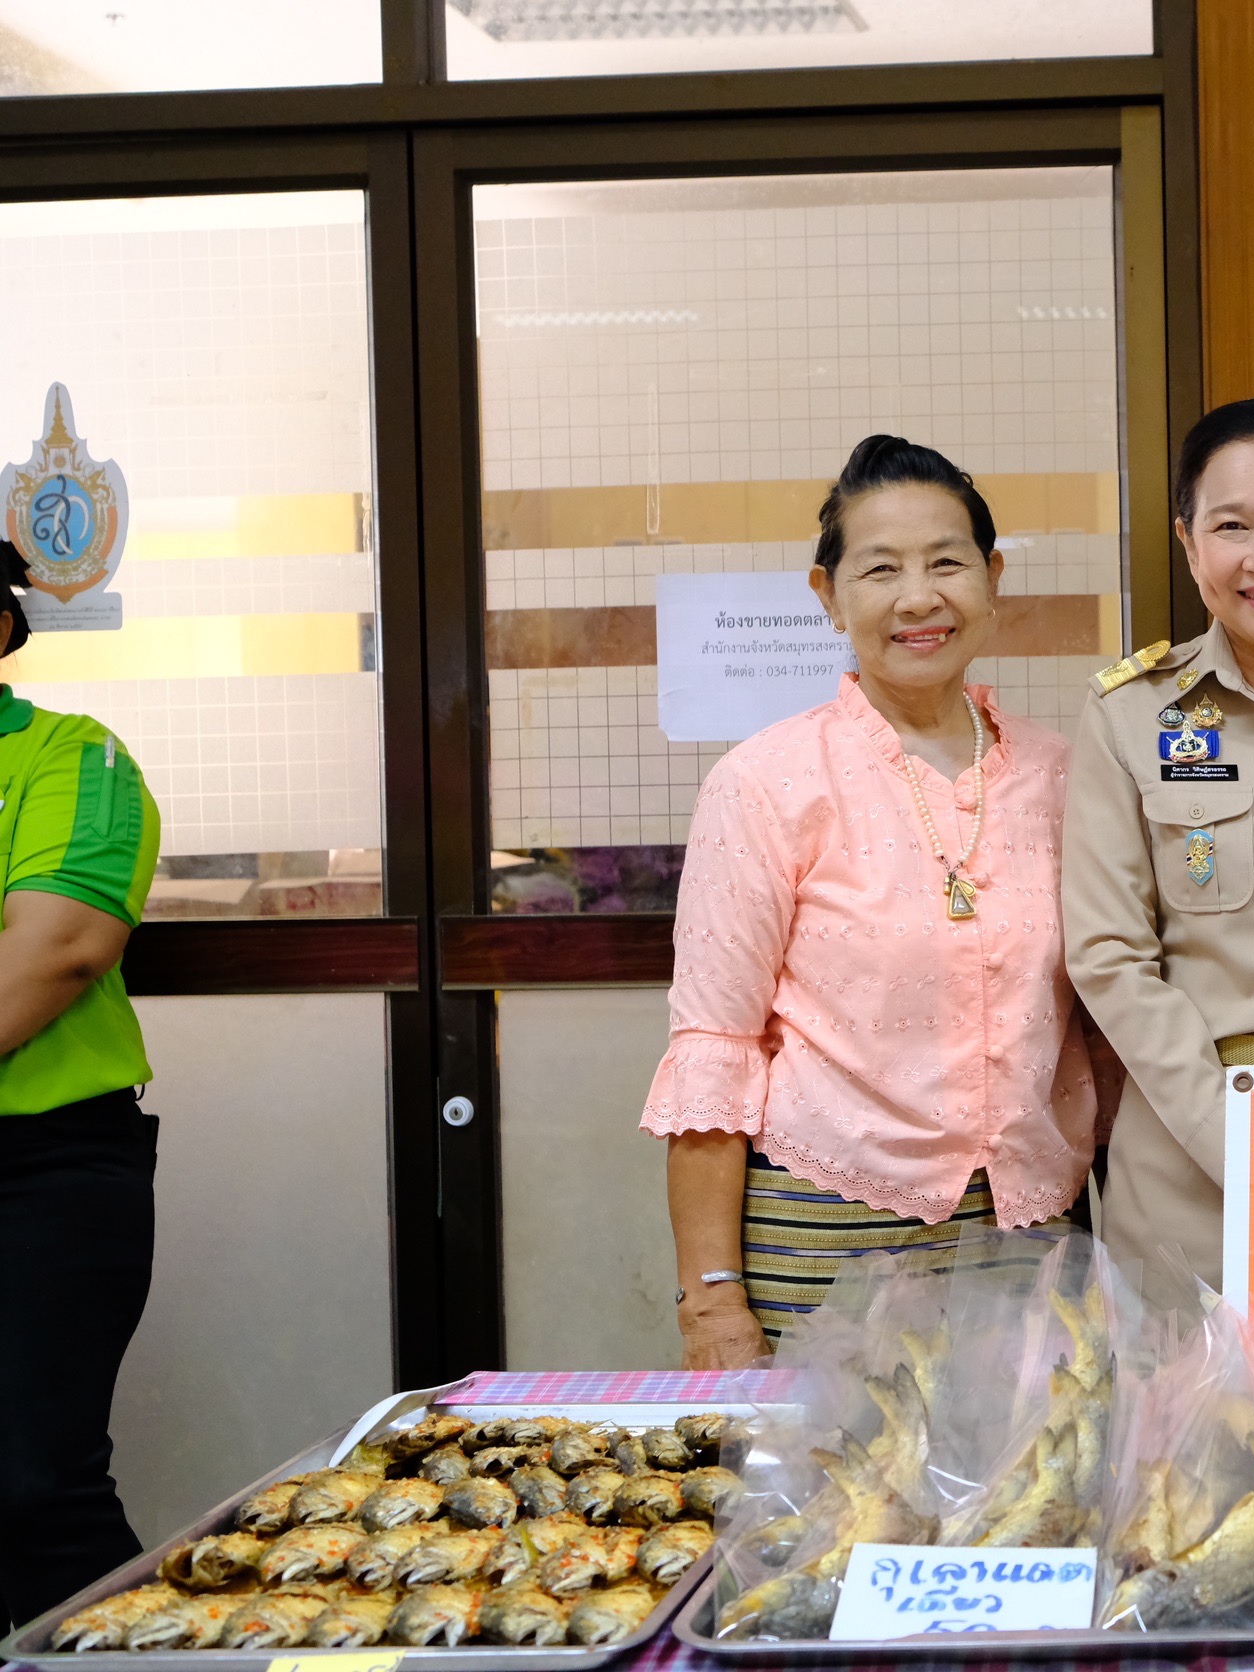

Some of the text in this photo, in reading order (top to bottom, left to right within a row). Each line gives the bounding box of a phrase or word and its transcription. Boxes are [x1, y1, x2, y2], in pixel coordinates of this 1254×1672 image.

[714, 611, 833, 629] ห้องขายทอดตลา
[724, 664, 755, 678] ติดต่อ
[766, 664, 834, 678] 034-711997
